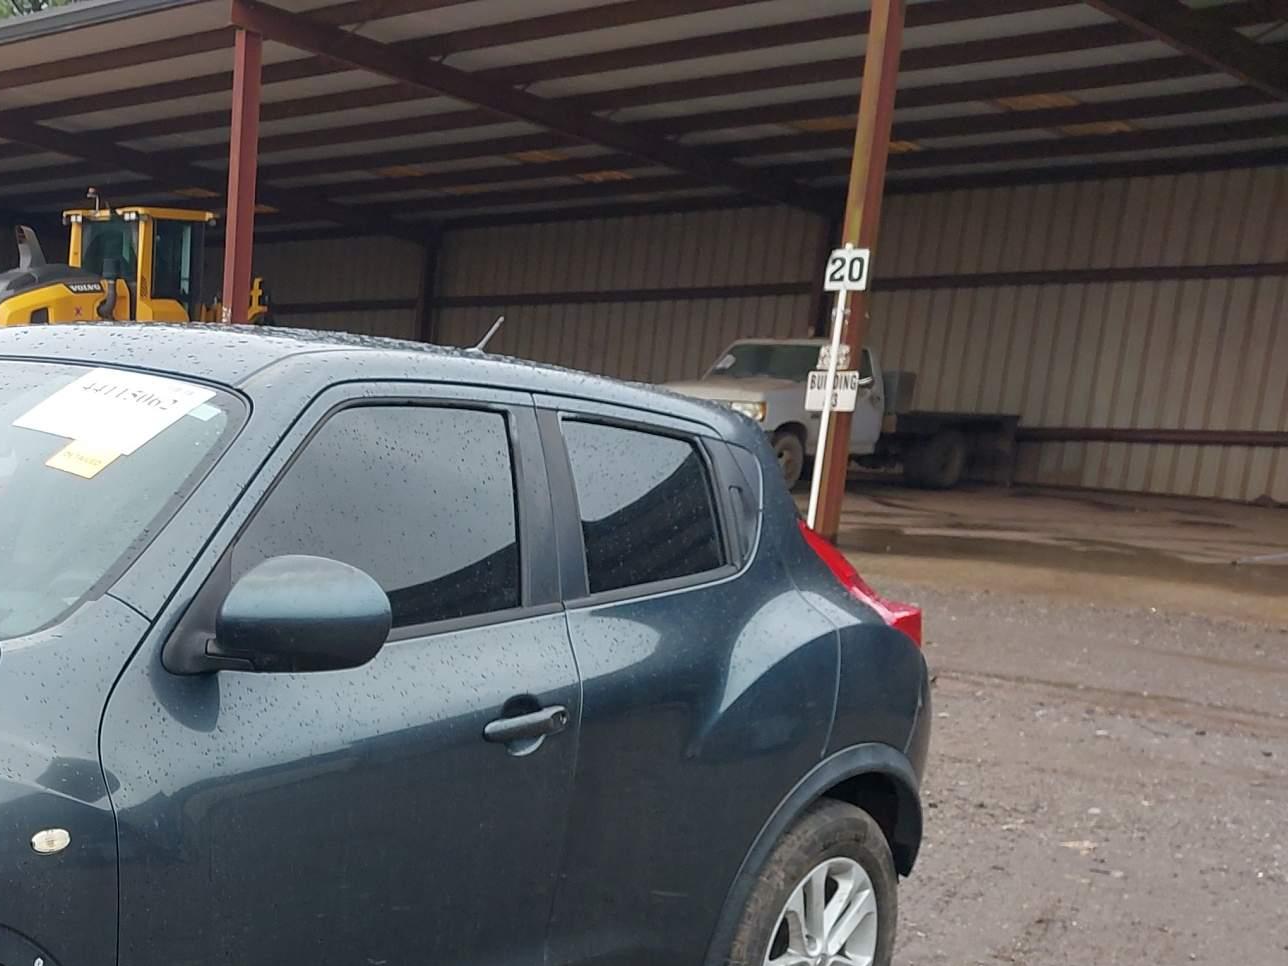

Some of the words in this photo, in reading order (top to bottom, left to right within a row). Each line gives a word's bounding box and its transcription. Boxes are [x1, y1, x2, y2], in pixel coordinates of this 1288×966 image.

[829, 257, 863, 282] 20
[69, 283, 101, 292] VOLVO
[810, 374, 857, 391] BUIDING
